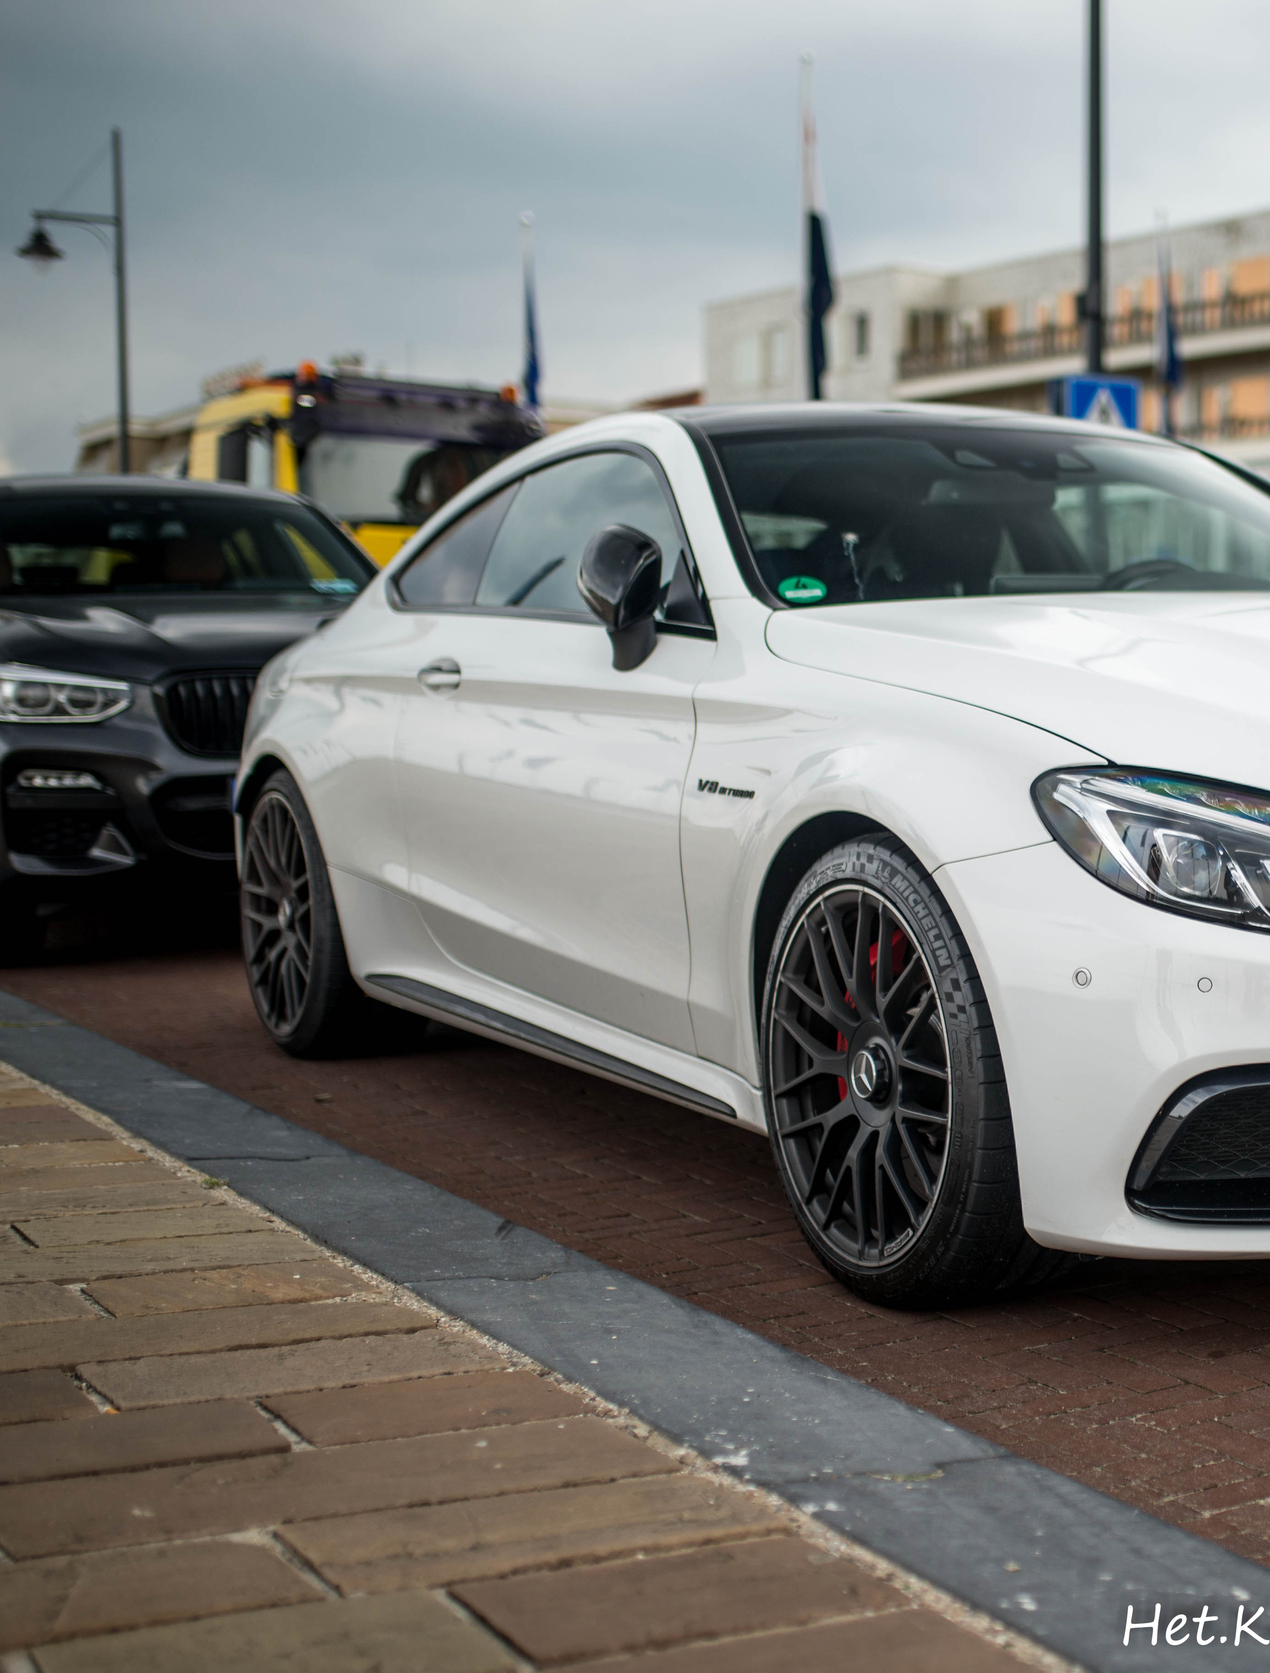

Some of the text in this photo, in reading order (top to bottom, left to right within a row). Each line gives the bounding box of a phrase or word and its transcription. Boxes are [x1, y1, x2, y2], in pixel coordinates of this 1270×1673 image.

[697, 778, 756, 800] V8 BITURBO
[890, 872, 952, 967] MICHELIN
